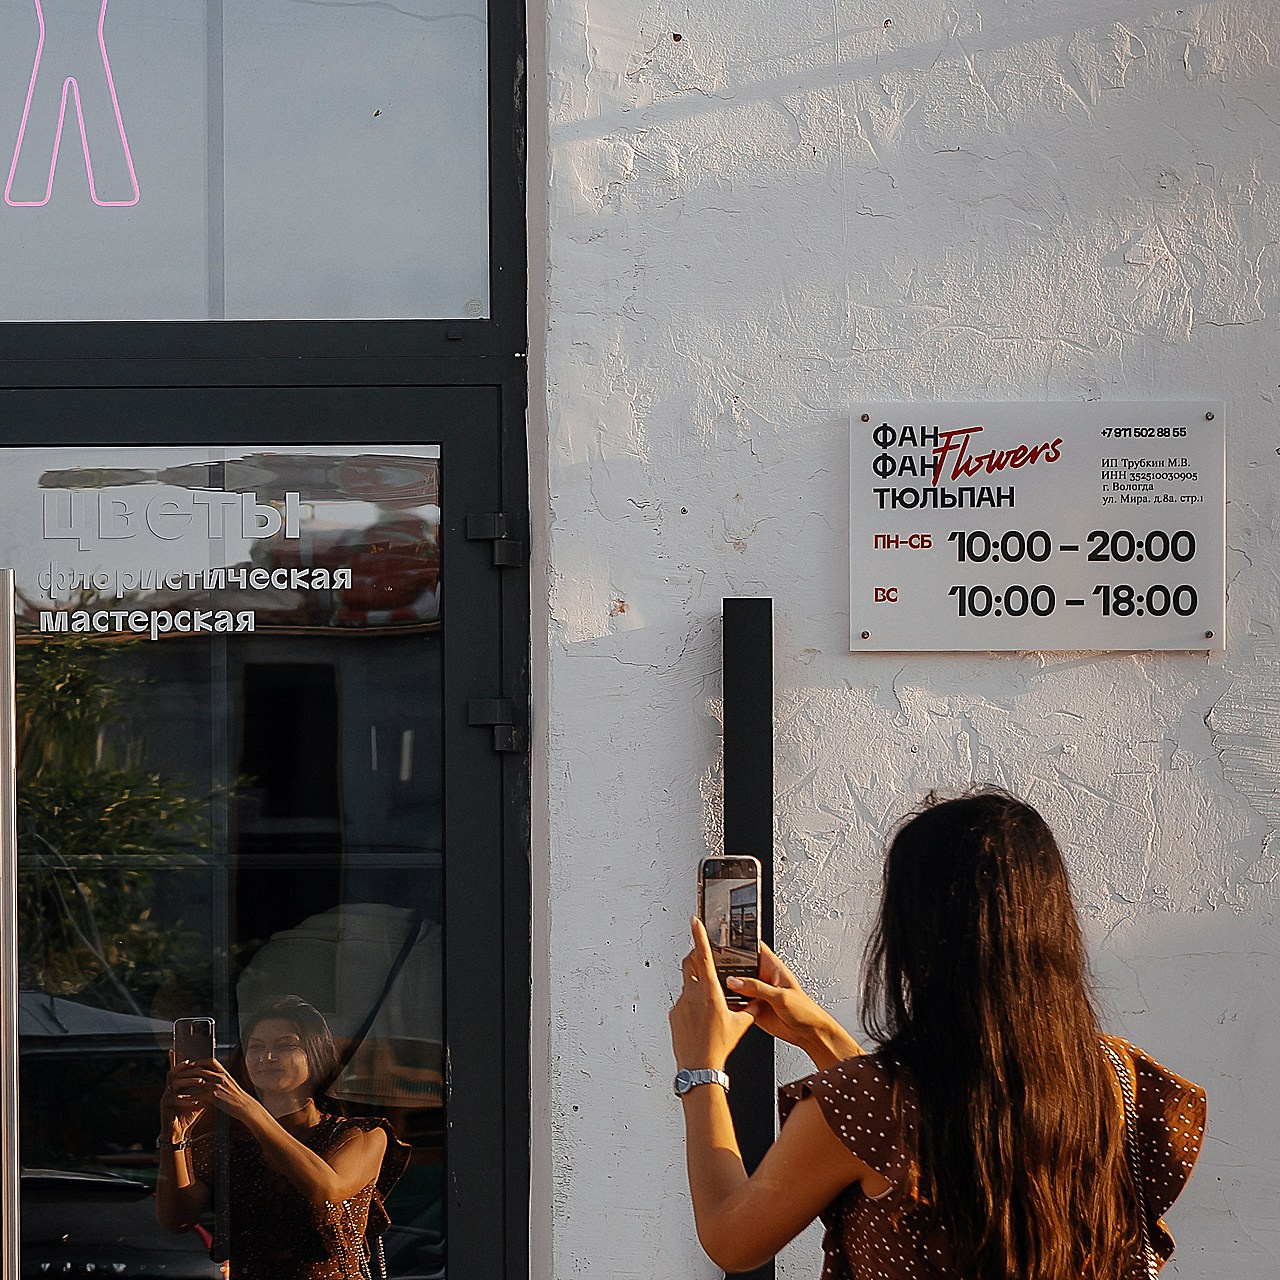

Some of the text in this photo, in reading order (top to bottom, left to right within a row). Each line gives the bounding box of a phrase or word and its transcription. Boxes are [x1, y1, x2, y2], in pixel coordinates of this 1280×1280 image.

[872, 422, 939, 450] ФАН
[1101, 427, 1187, 438] +7 911 502 88 55
[872, 452, 938, 480] ФАН
[932, 426, 1063, 487] Flowers
[1101, 457, 1191, 470] ИП Трубкин М.В.
[1101, 470, 1198, 482] ИНН 352510030905
[1112, 482, 1154, 492] Вологда
[873, 486, 1015, 510] ТЮЛЬПАН
[1102, 496, 1117, 505] ул.
[41, 491, 302, 552] цветы
[874, 533, 933, 550] ПН-СБ
[948, 530, 1052, 563] 10:00
[1086, 529, 1197, 563] 20:00
[37, 561, 353, 599] флористическая
[874, 587, 899, 603] ВС
[948, 584, 1056, 617] 10:00
[1092, 583, 1198, 617] 18:00
[38, 608, 257, 641] мастерская
